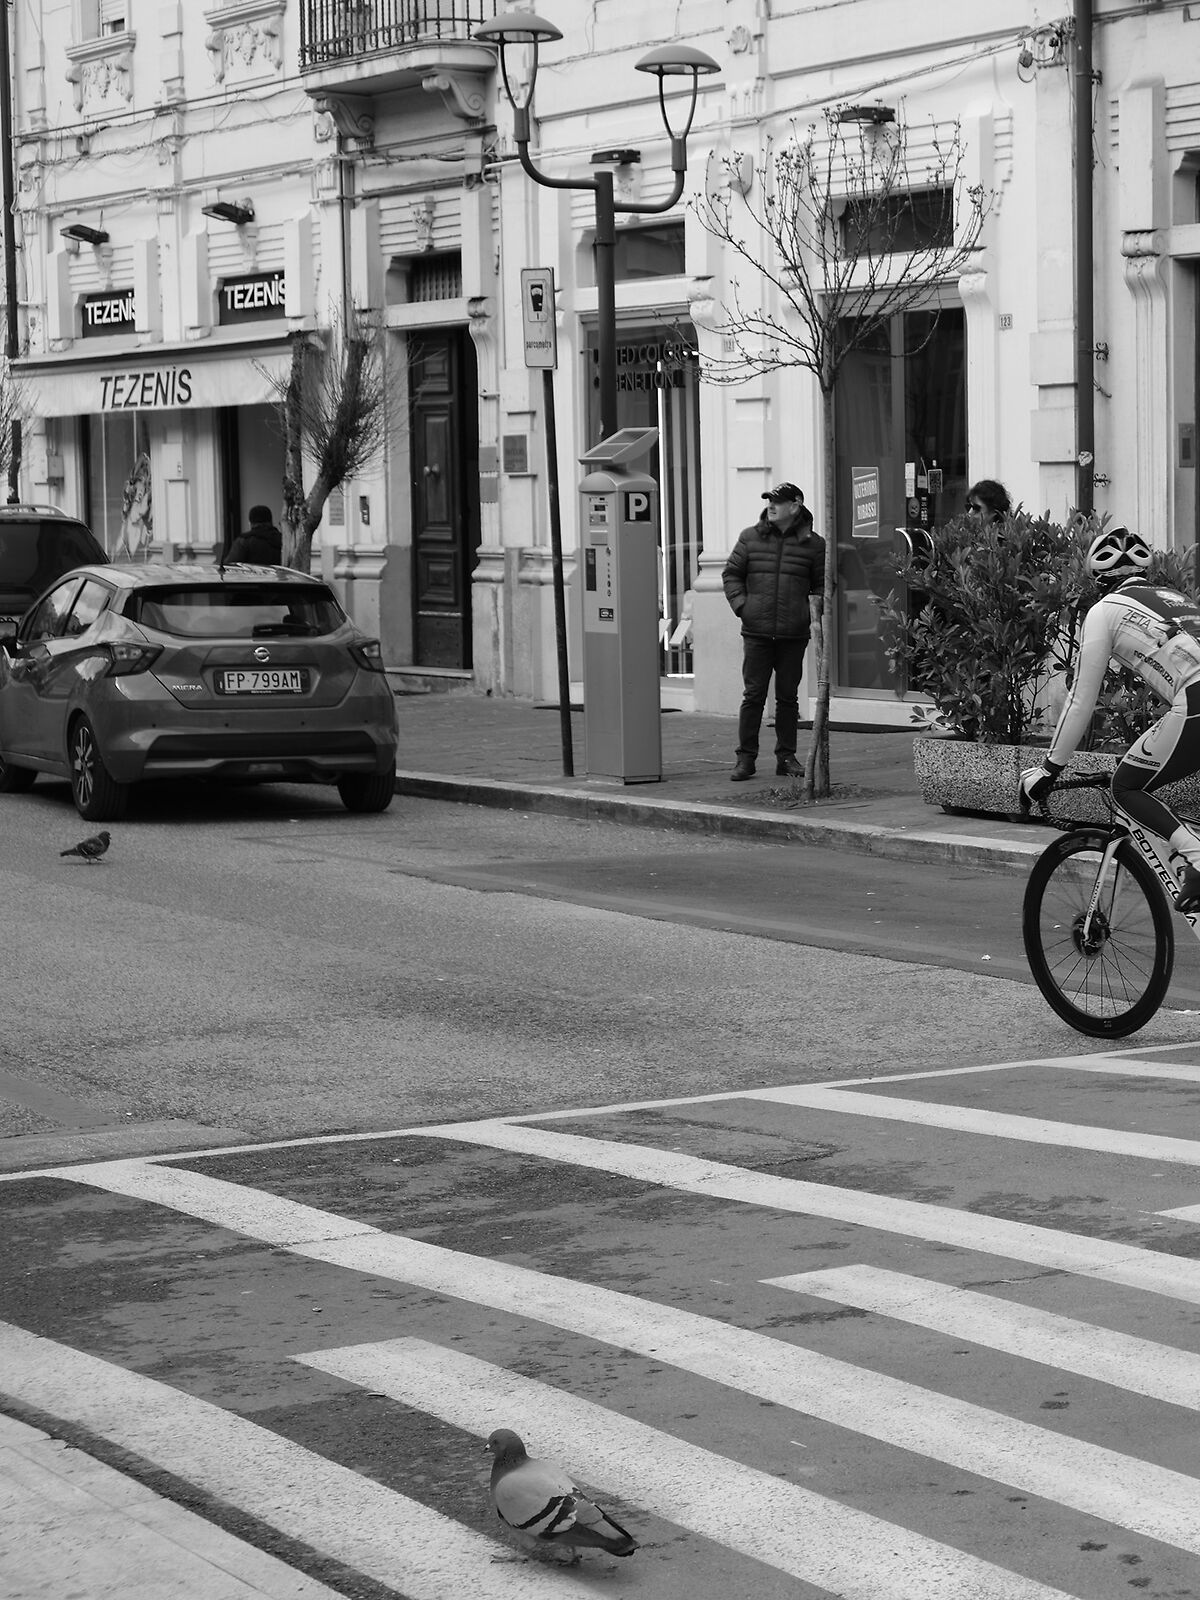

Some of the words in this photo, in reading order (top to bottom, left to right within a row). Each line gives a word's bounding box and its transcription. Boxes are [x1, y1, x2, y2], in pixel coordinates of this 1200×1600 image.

[1000, 316, 1011, 327] 123
[100, 366, 192, 410] TEZENIS
[628, 493, 648, 520] P
[857, 502, 877, 520] RIBASSI
[1122, 609, 1152, 630] ZETA
[172, 684, 203, 692] MICRA
